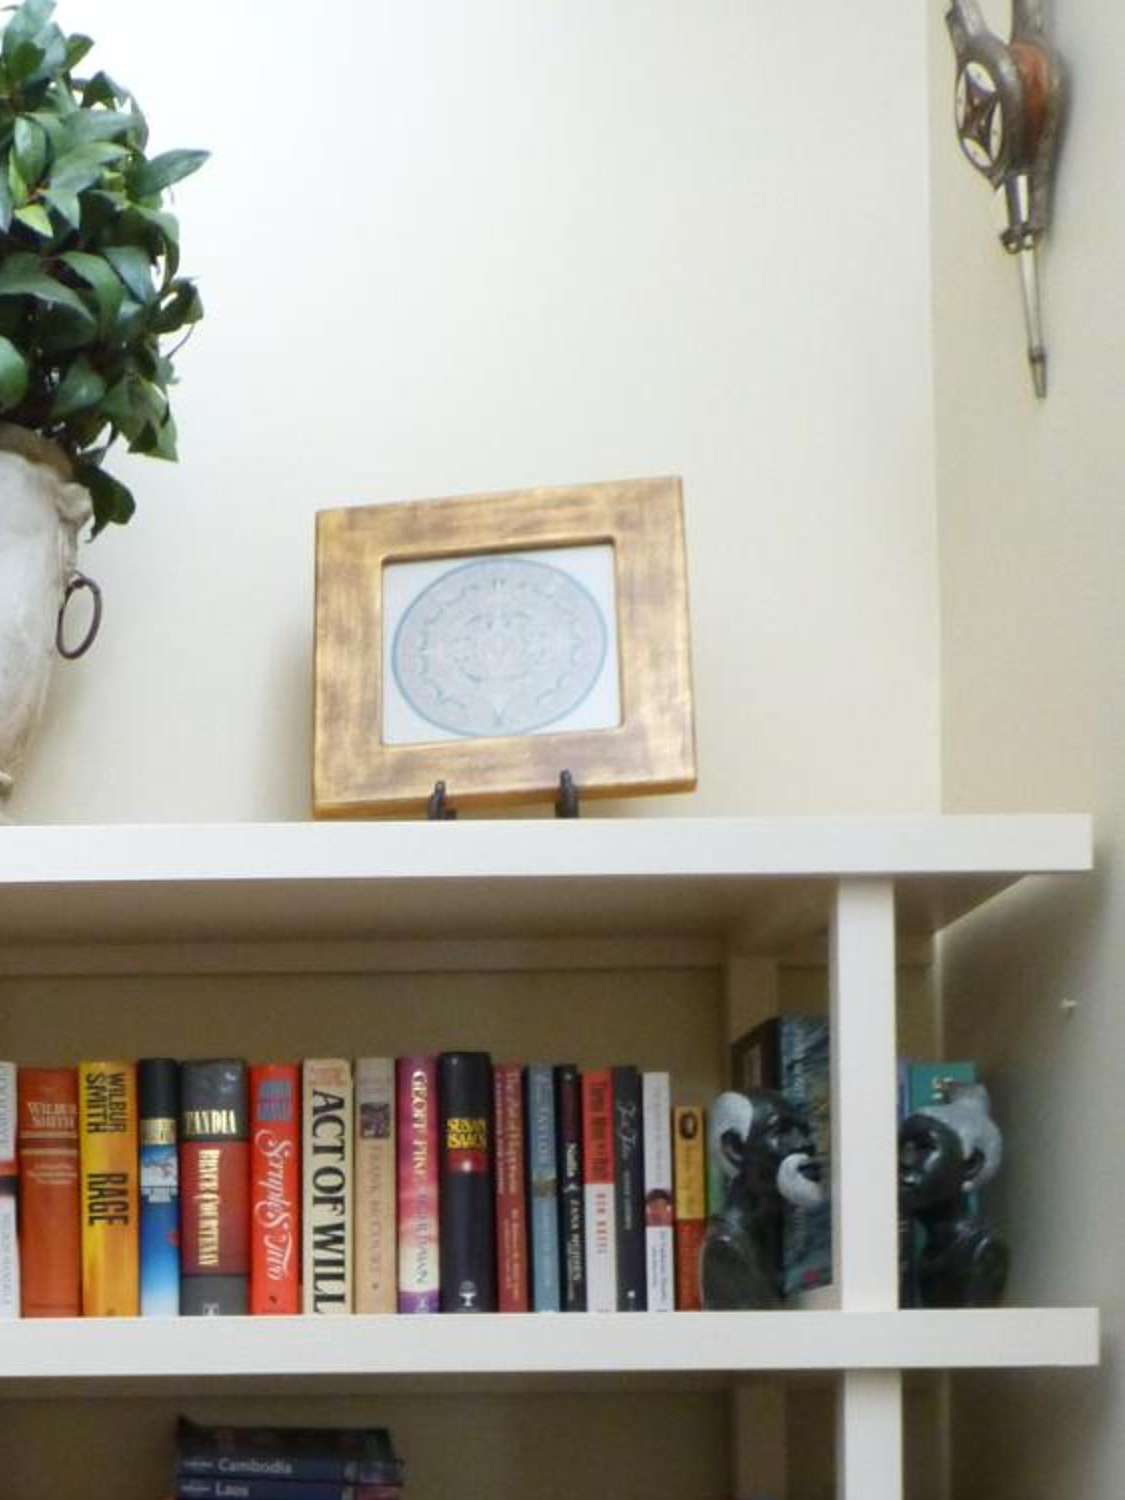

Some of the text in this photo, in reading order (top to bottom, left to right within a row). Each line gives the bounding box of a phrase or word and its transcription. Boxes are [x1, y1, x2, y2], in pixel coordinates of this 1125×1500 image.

[86, 1073, 109, 1134] SMITH
[108, 1073, 127, 1133] WILBUR
[87, 1172, 129, 1226] RAGE
[313, 1090, 346, 1312] ACT OF WILL
